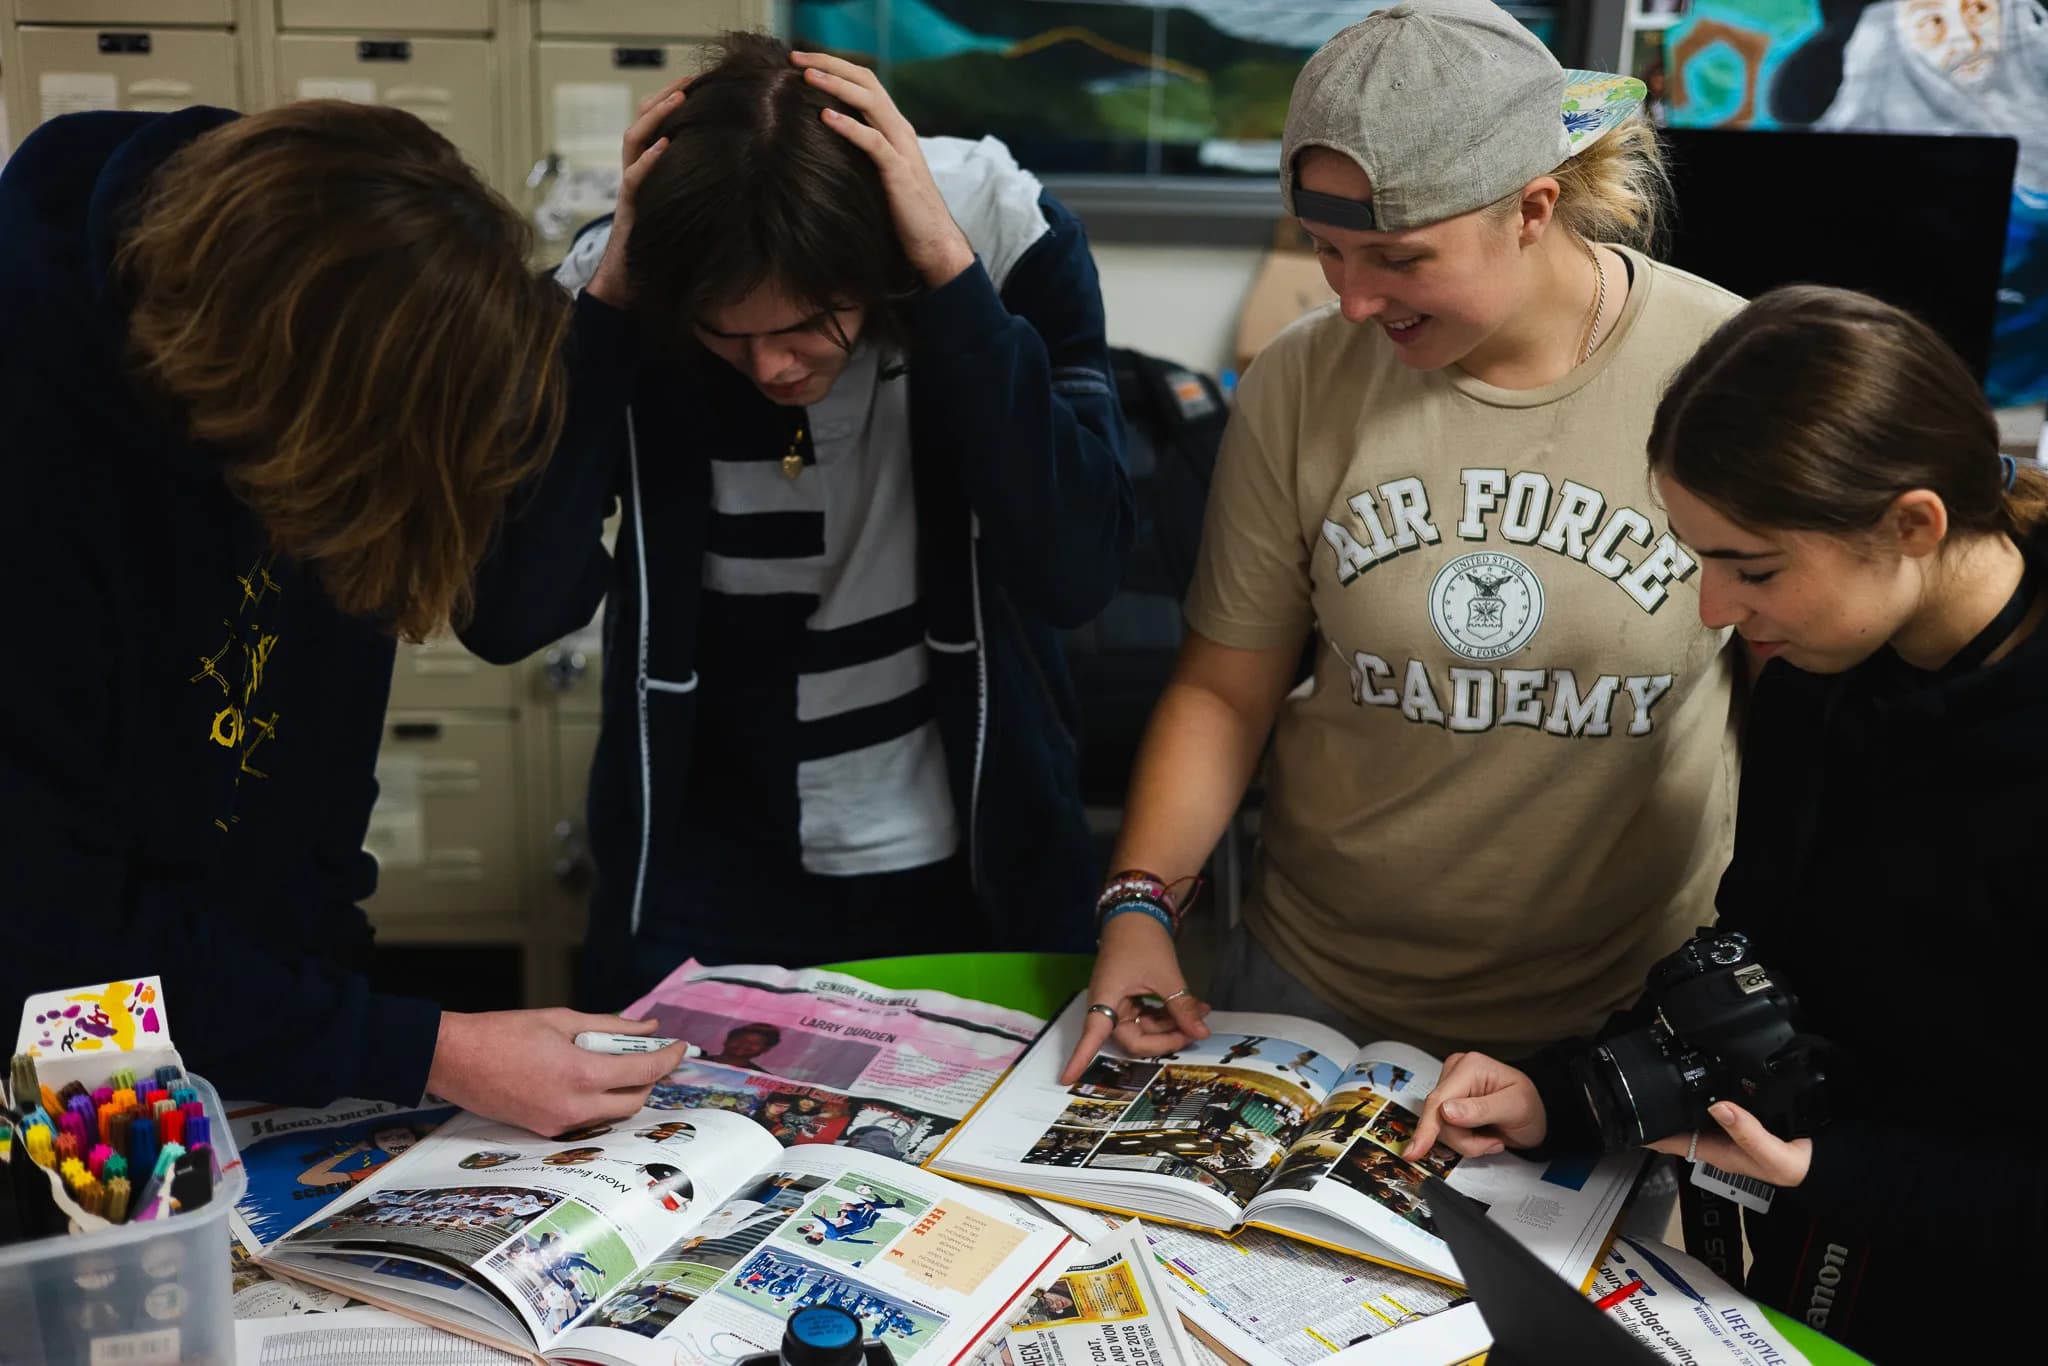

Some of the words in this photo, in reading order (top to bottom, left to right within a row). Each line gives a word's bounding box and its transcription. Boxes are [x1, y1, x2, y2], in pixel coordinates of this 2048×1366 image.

[1322, 476, 1440, 587] AIR
[1457, 468, 1697, 614] FORCE
[1452, 556, 1489, 573] UNITED
[1493, 556, 1526, 577] STATES
[1455, 643, 1472, 657] AIR
[1477, 643, 1511, 657] FORCE
[1351, 651, 1674, 737] CADEMY
[814, 980, 858, 996] SENIOR
[859, 990, 919, 1008] FAREWELL
[799, 1016, 841, 1033] LARRY
[843, 1025, 897, 1044] DURDEN
[594, 1173, 632, 1193] Most
[1630, 1297, 1670, 1336] budget
[1693, 1306, 1722, 1337] WEDNESDAY
[1101, 1324, 1120, 1343] WON
[1122, 1325, 1140, 1345] 2018
[1720, 1308, 1751, 1332] LIFE
[1748, 1338, 1786, 1366] STYLE
[1088, 1338, 1107, 1362] COAT,
[1109, 1345, 1127, 1362] AND
[1130, 1347, 1145, 1358] OF
